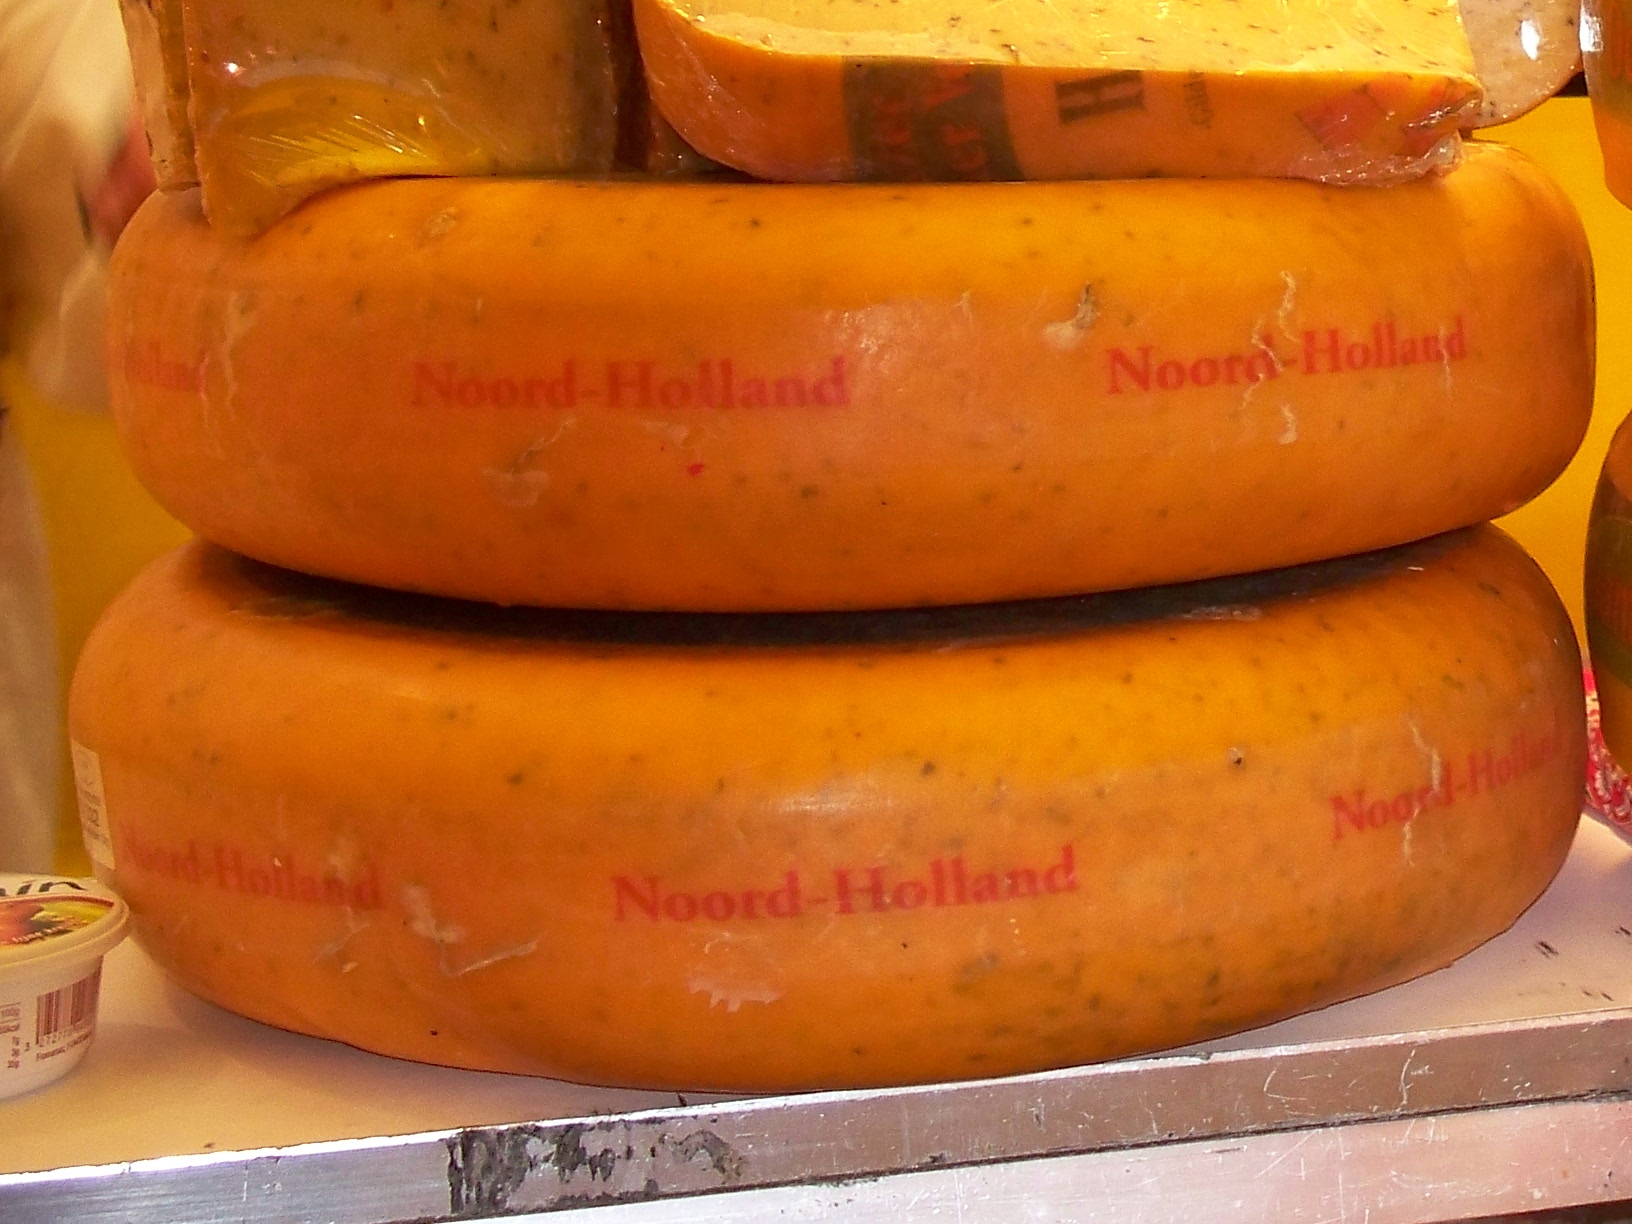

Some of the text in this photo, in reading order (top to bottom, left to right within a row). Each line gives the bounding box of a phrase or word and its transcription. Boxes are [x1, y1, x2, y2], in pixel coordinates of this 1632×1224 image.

[409, 353, 854, 413] Noord-Holland
[1104, 312, 1469, 396] Noord-Holland
[611, 843, 1081, 926] Noord-Holland
